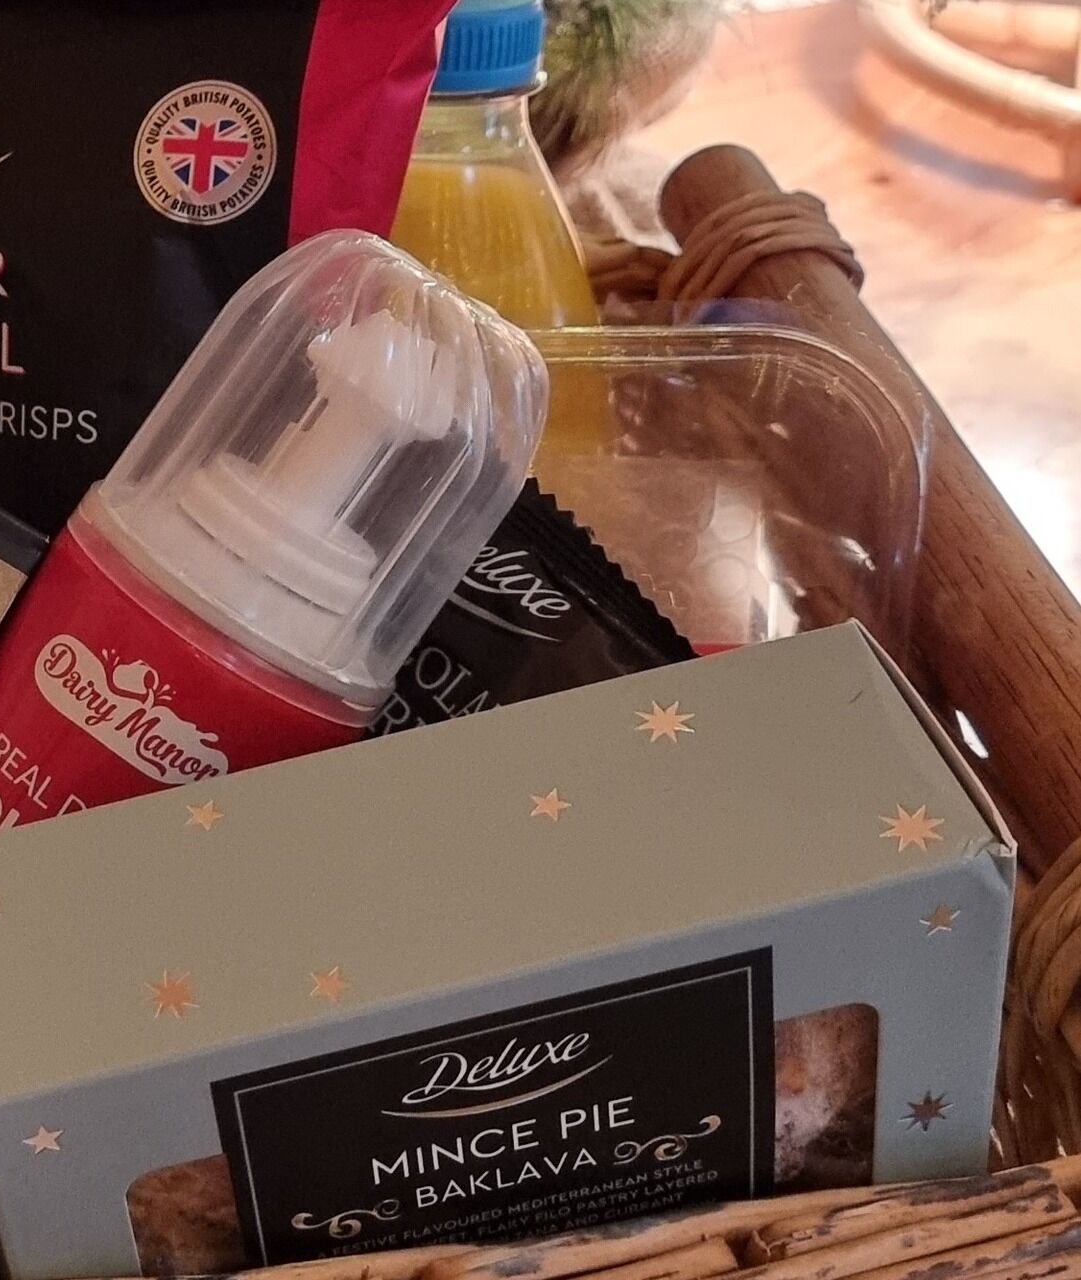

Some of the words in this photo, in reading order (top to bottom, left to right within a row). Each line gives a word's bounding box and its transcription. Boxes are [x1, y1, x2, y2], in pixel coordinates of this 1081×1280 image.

[146, 101, 181, 145] QUALITY
[182, 90, 230, 108] BRITISH
[229, 98, 267, 151] POTATOES
[140, 159, 172, 204] QUALITY
[170, 198, 217, 217] BRITISH
[220, 164, 265, 213] POTATOES
[467, 545, 571, 619] eluxe
[43, 642, 118, 726] Dairy
[114, 708, 221, 782] Manor
[402, 1032, 589, 1104] Deluxe
[371, 1118, 540, 1186] MINCE
[560, 1095, 636, 1140] PIE
[332, 1233, 398, 1256] FESTIVE
[402, 1208, 503, 1240] FLAVOURED
[507, 1173, 648, 1215] MEDITERRANEAN
[653, 1159, 704, 1181] STYLE
[415, 1147, 597, 1209] BAKLAVA
[575, 1190, 639, 1212] PASTRY
[644, 1170, 719, 1197] LAYERED
